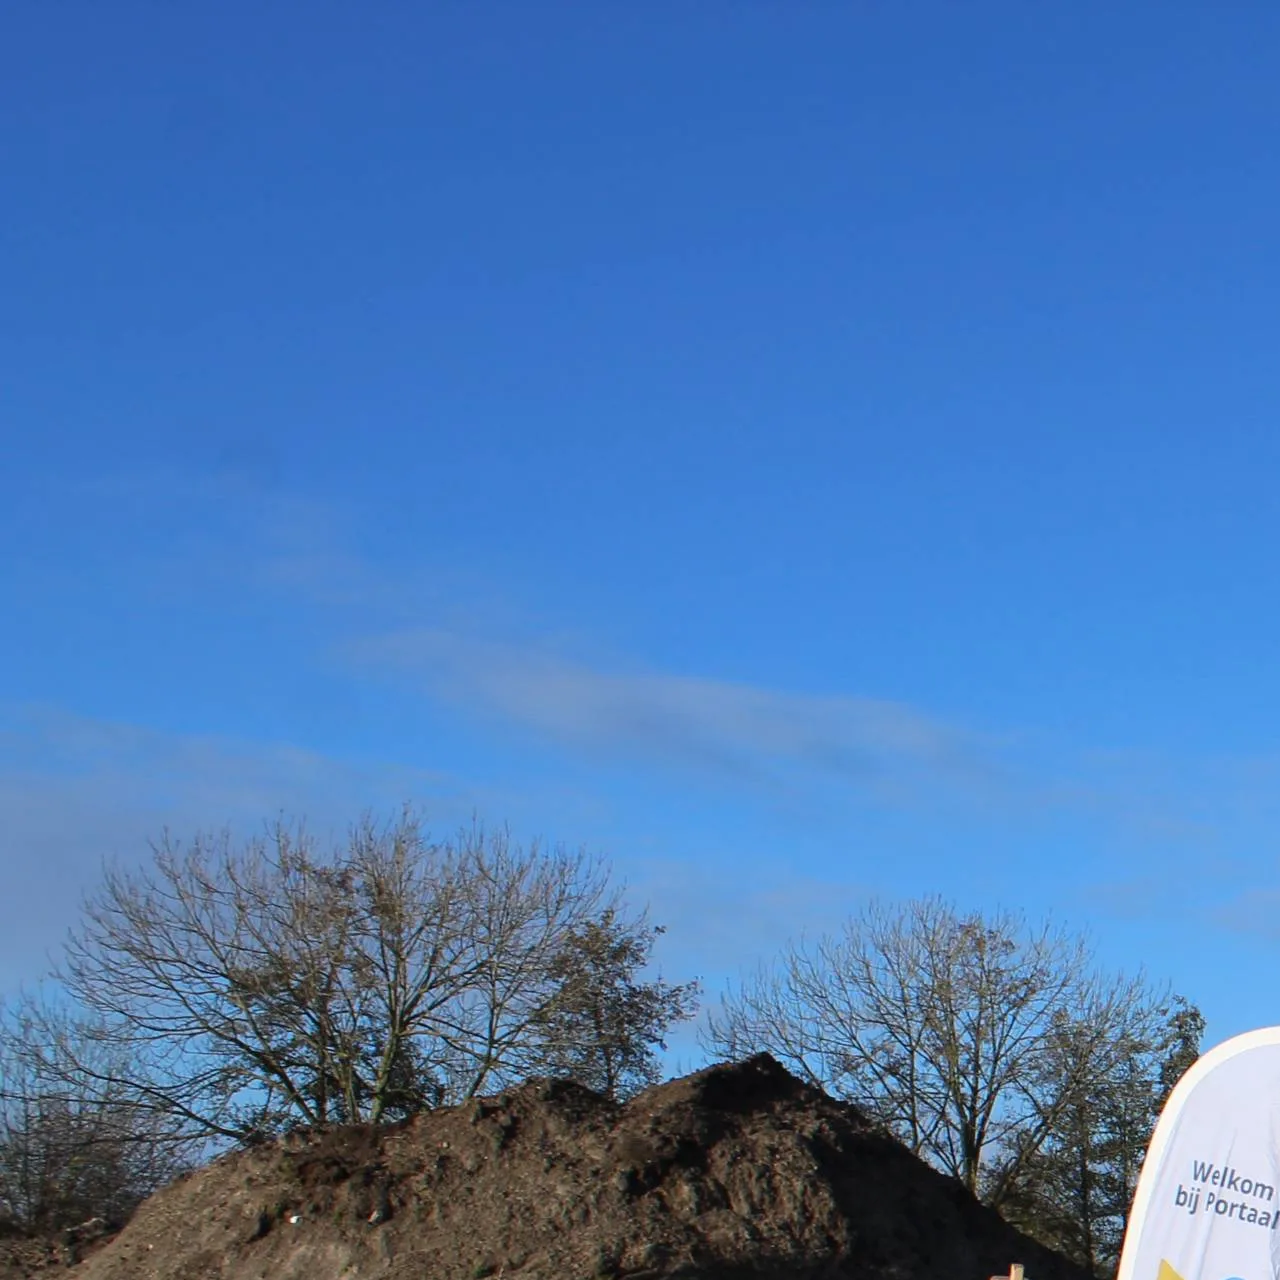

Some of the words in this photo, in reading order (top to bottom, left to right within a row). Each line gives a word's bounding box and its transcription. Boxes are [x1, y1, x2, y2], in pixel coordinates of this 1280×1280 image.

[1193, 1160, 1274, 1201] Welkom
[1175, 1184, 1201, 1215] bij
[1205, 1192, 1280, 1229] Portaal
